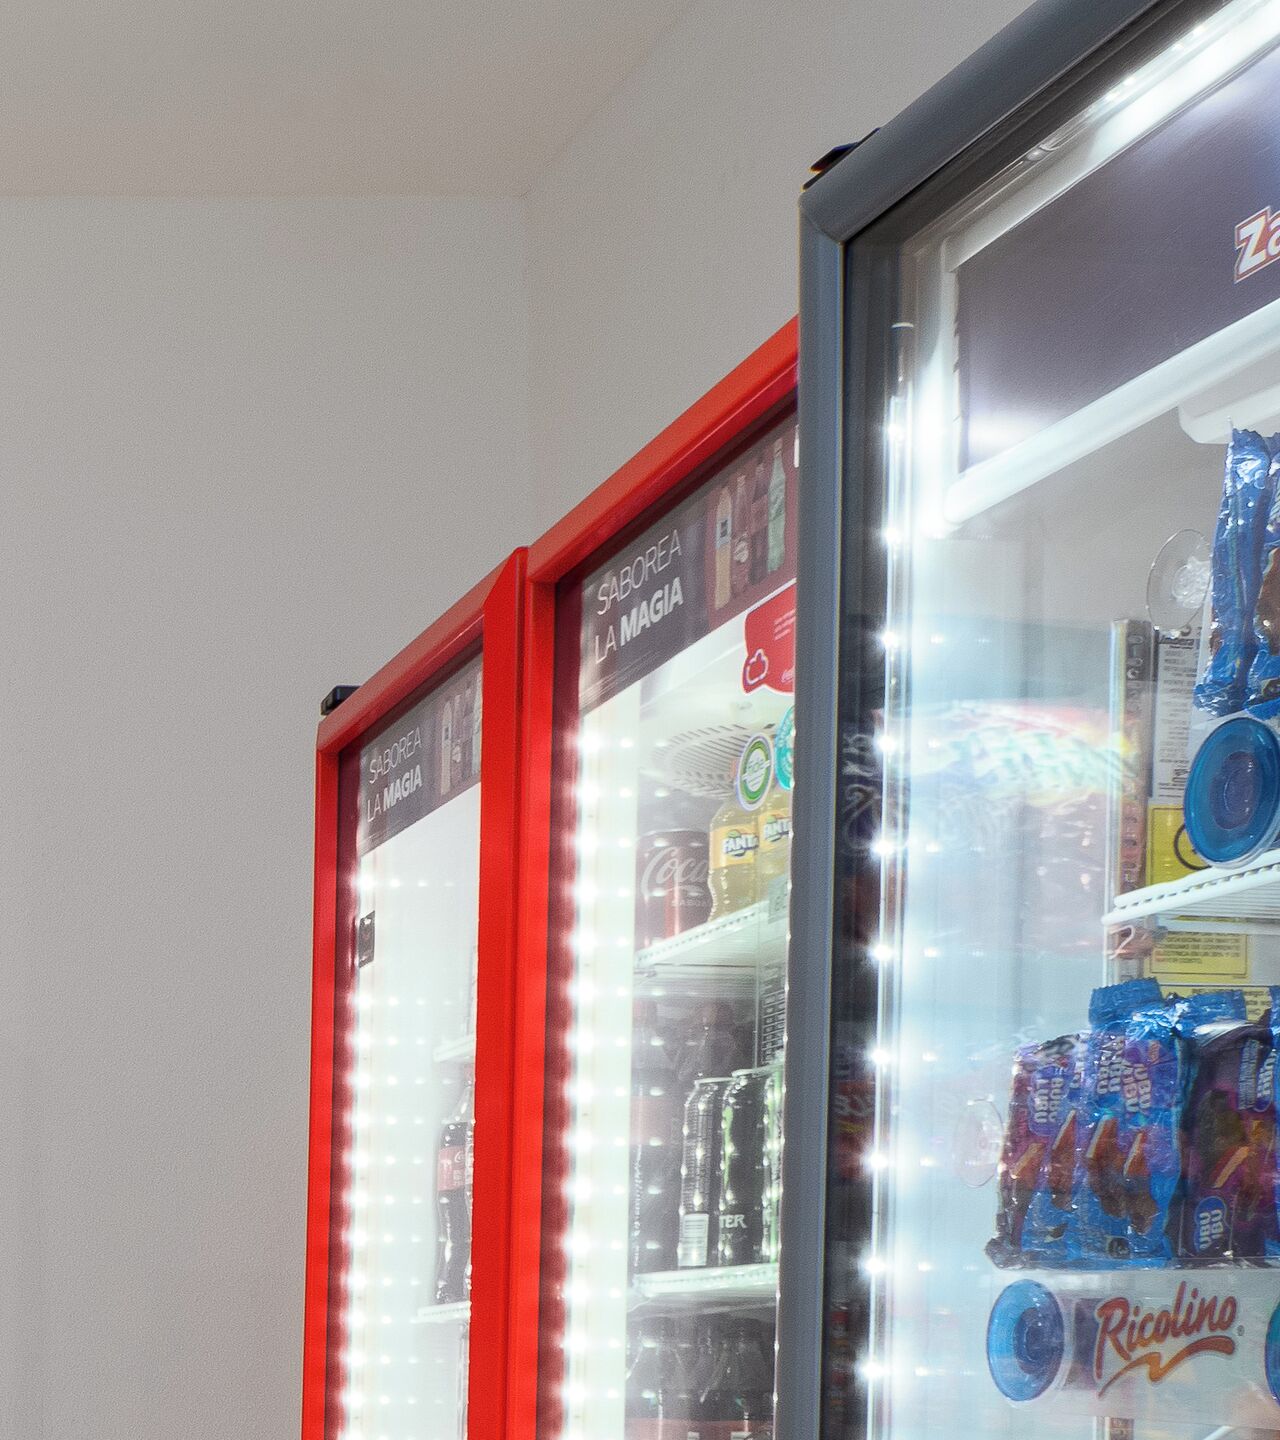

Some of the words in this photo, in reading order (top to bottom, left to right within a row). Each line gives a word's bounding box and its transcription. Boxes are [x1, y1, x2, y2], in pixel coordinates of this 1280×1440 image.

[597, 529, 682, 616] SABOREA
[594, 628, 618, 665] LA
[620, 577, 684, 648] MAGIA
[367, 795, 383, 823] LA
[383, 764, 423, 811] MAGIA
[369, 726, 423, 785] SABOREA
[1097, 1280, 1238, 1362] Ricolino
